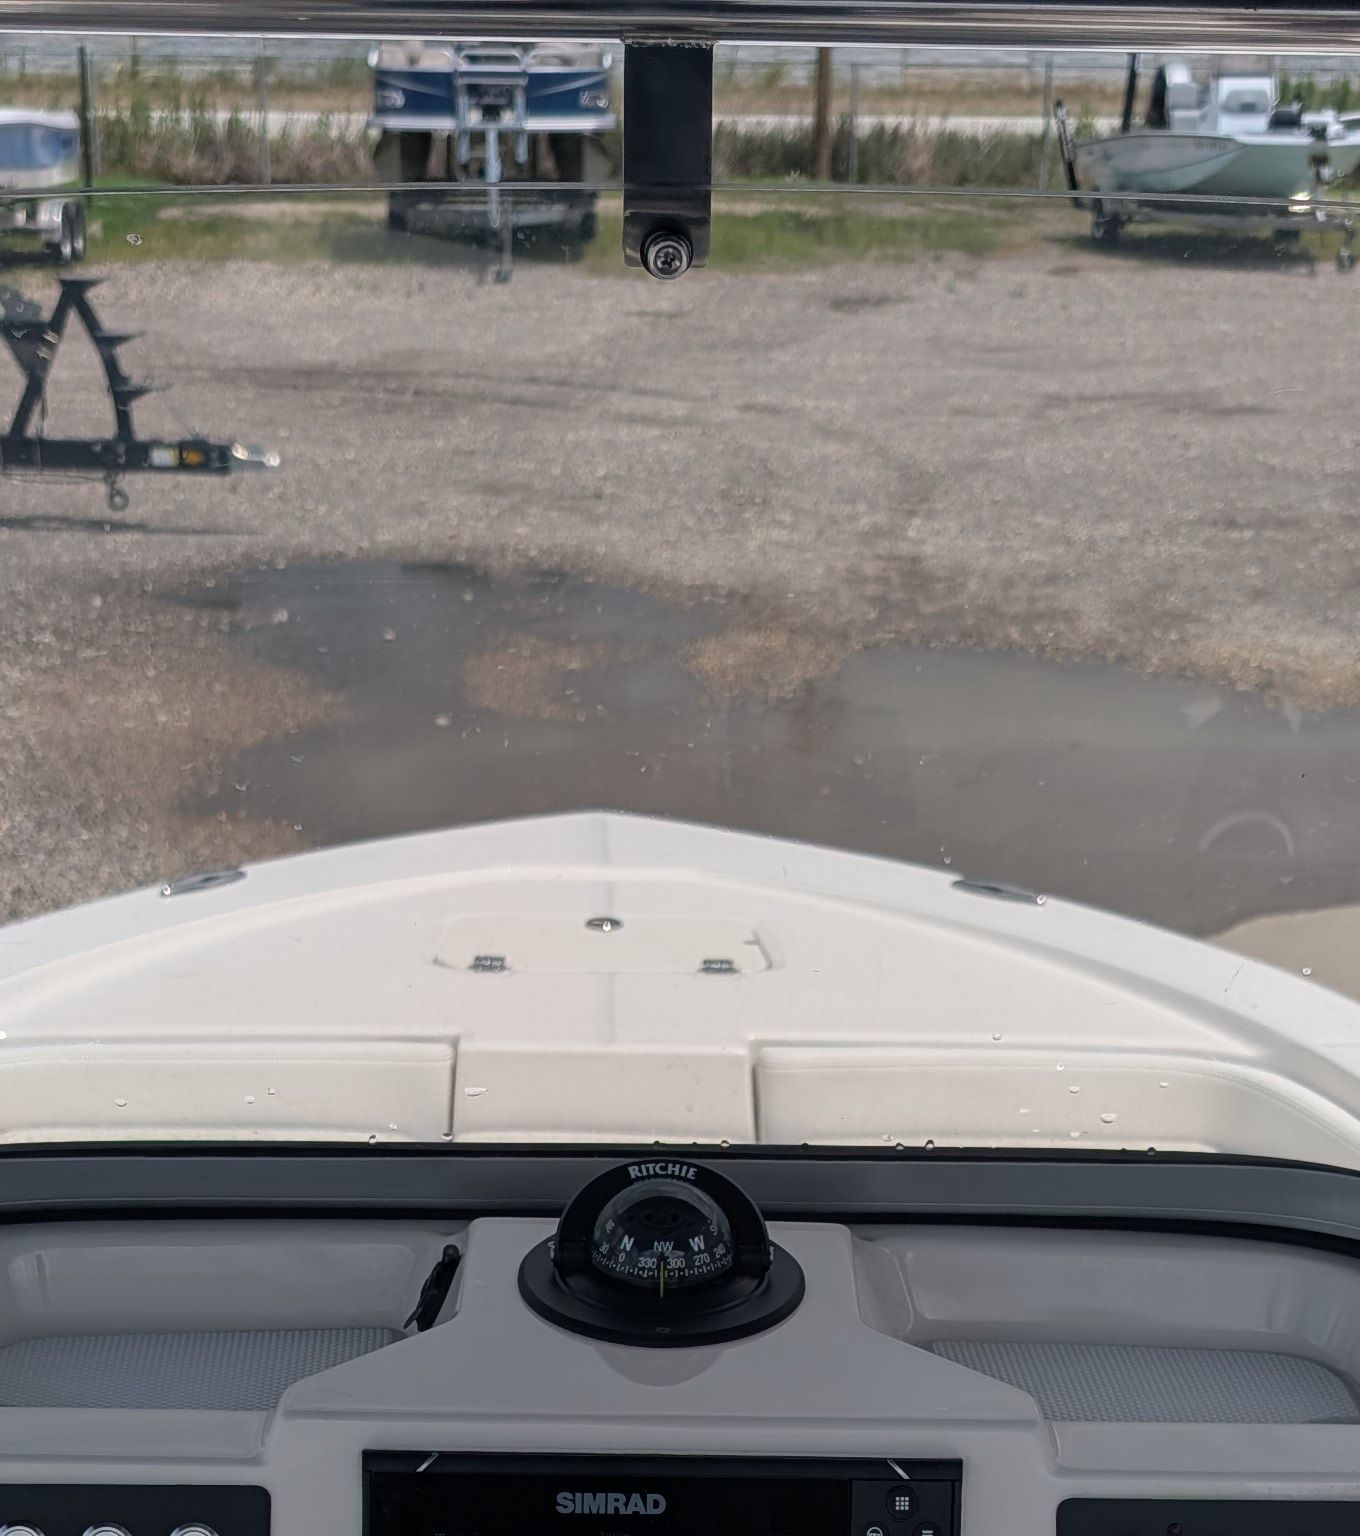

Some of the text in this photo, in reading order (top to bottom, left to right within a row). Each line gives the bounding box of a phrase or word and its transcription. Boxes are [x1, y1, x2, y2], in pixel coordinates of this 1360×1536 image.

[627, 1163, 698, 1180] RITCHIE
[620, 1234, 635, 1251] N
[654, 1241, 674, 1251] NW
[688, 1234, 705, 1252] W
[639, 1257, 657, 1269] 330
[667, 1258, 686, 1269] 300
[693, 1253, 710, 1265] 270
[555, 1492, 666, 1515] SIMRAD
